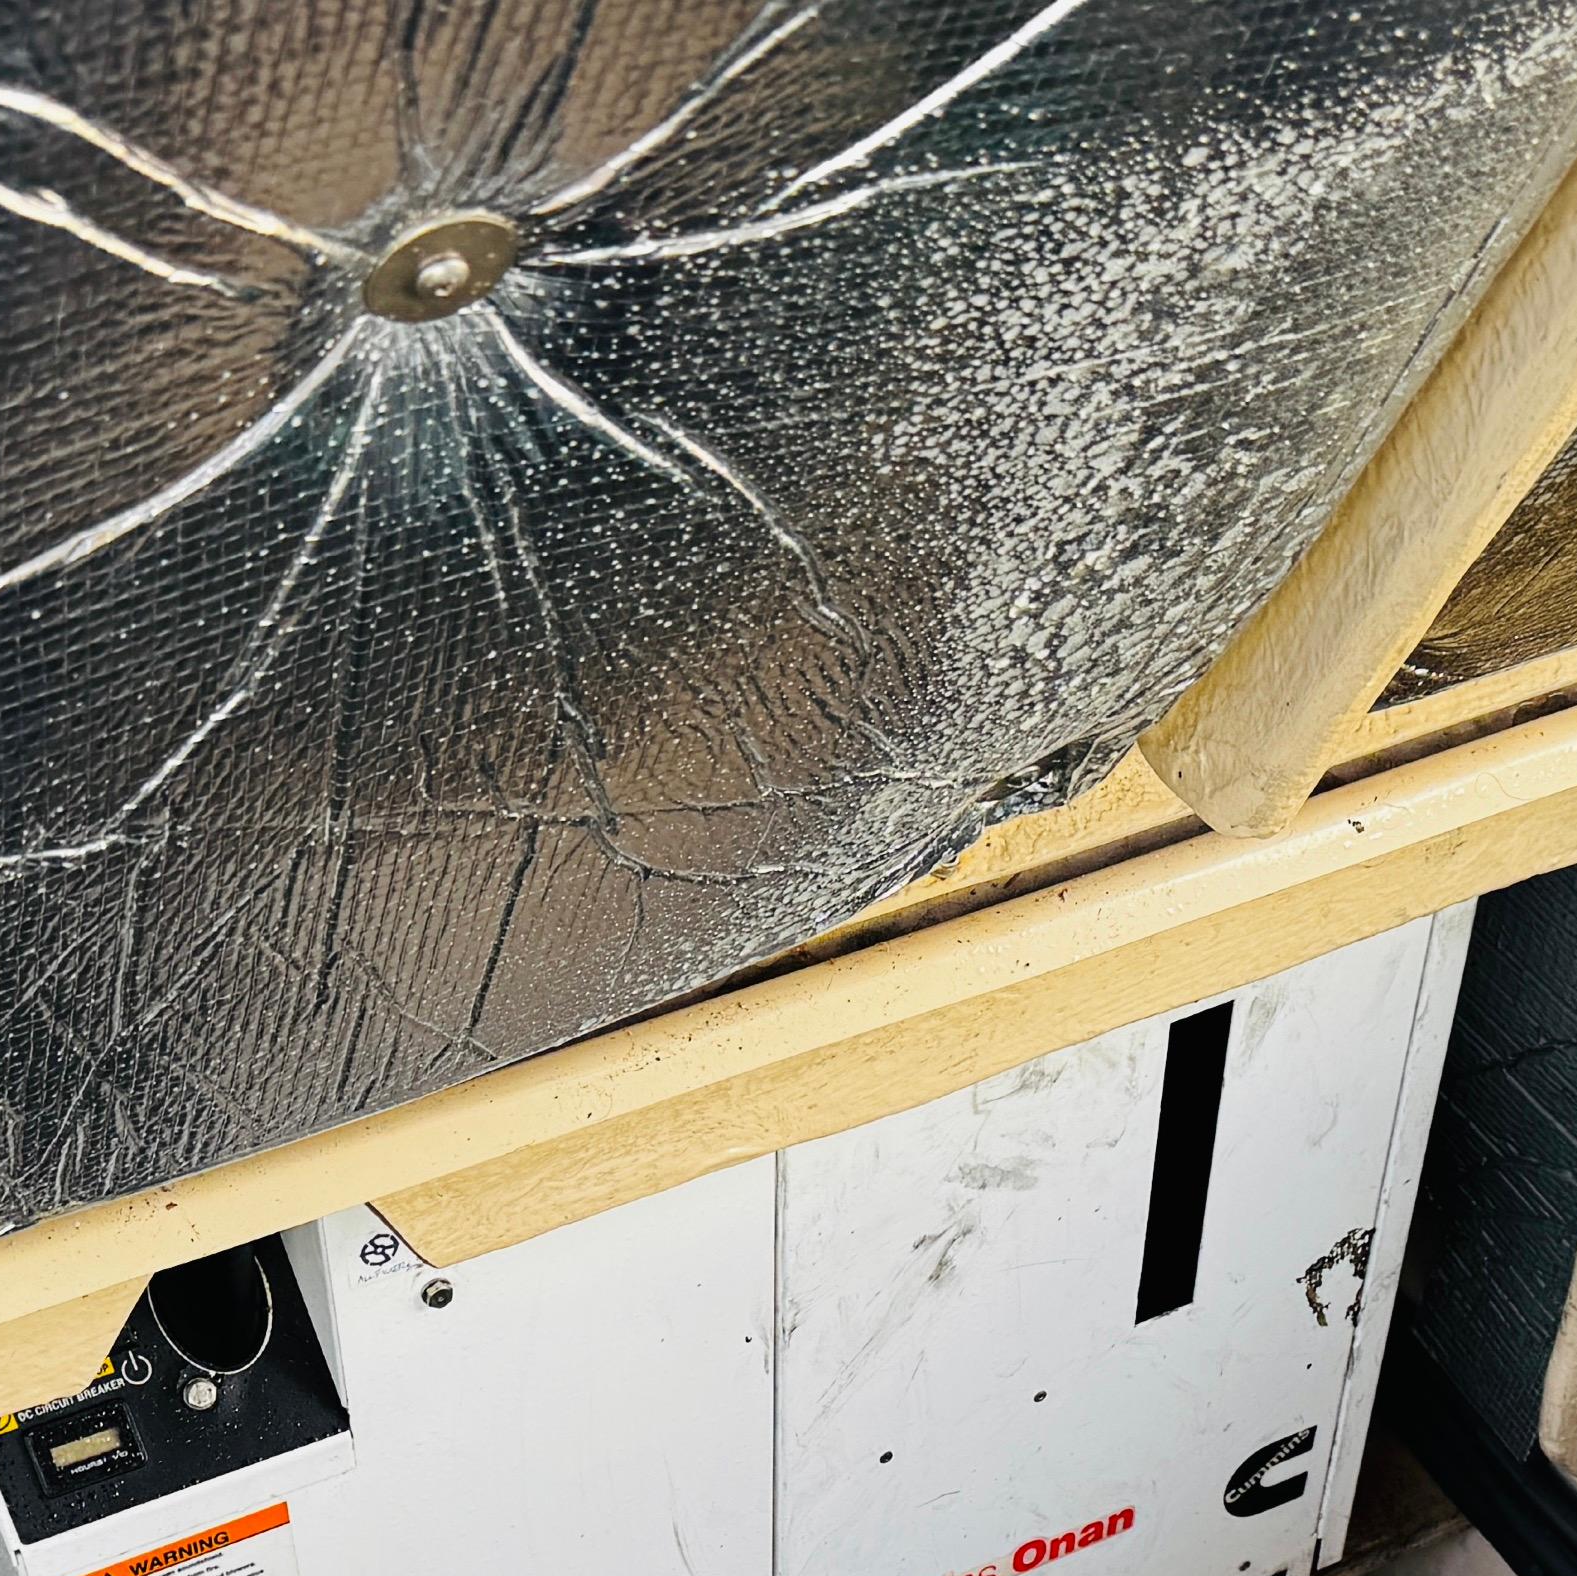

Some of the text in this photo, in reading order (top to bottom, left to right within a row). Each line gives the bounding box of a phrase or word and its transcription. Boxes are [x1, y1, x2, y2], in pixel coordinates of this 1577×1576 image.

[17, 1377, 125, 1422] DC CIRCUIT BREAKER
[1225, 1429, 1310, 1504] Cummins
[129, 1531, 230, 1576] WARNING
[1011, 1506, 1136, 1575] Onan
